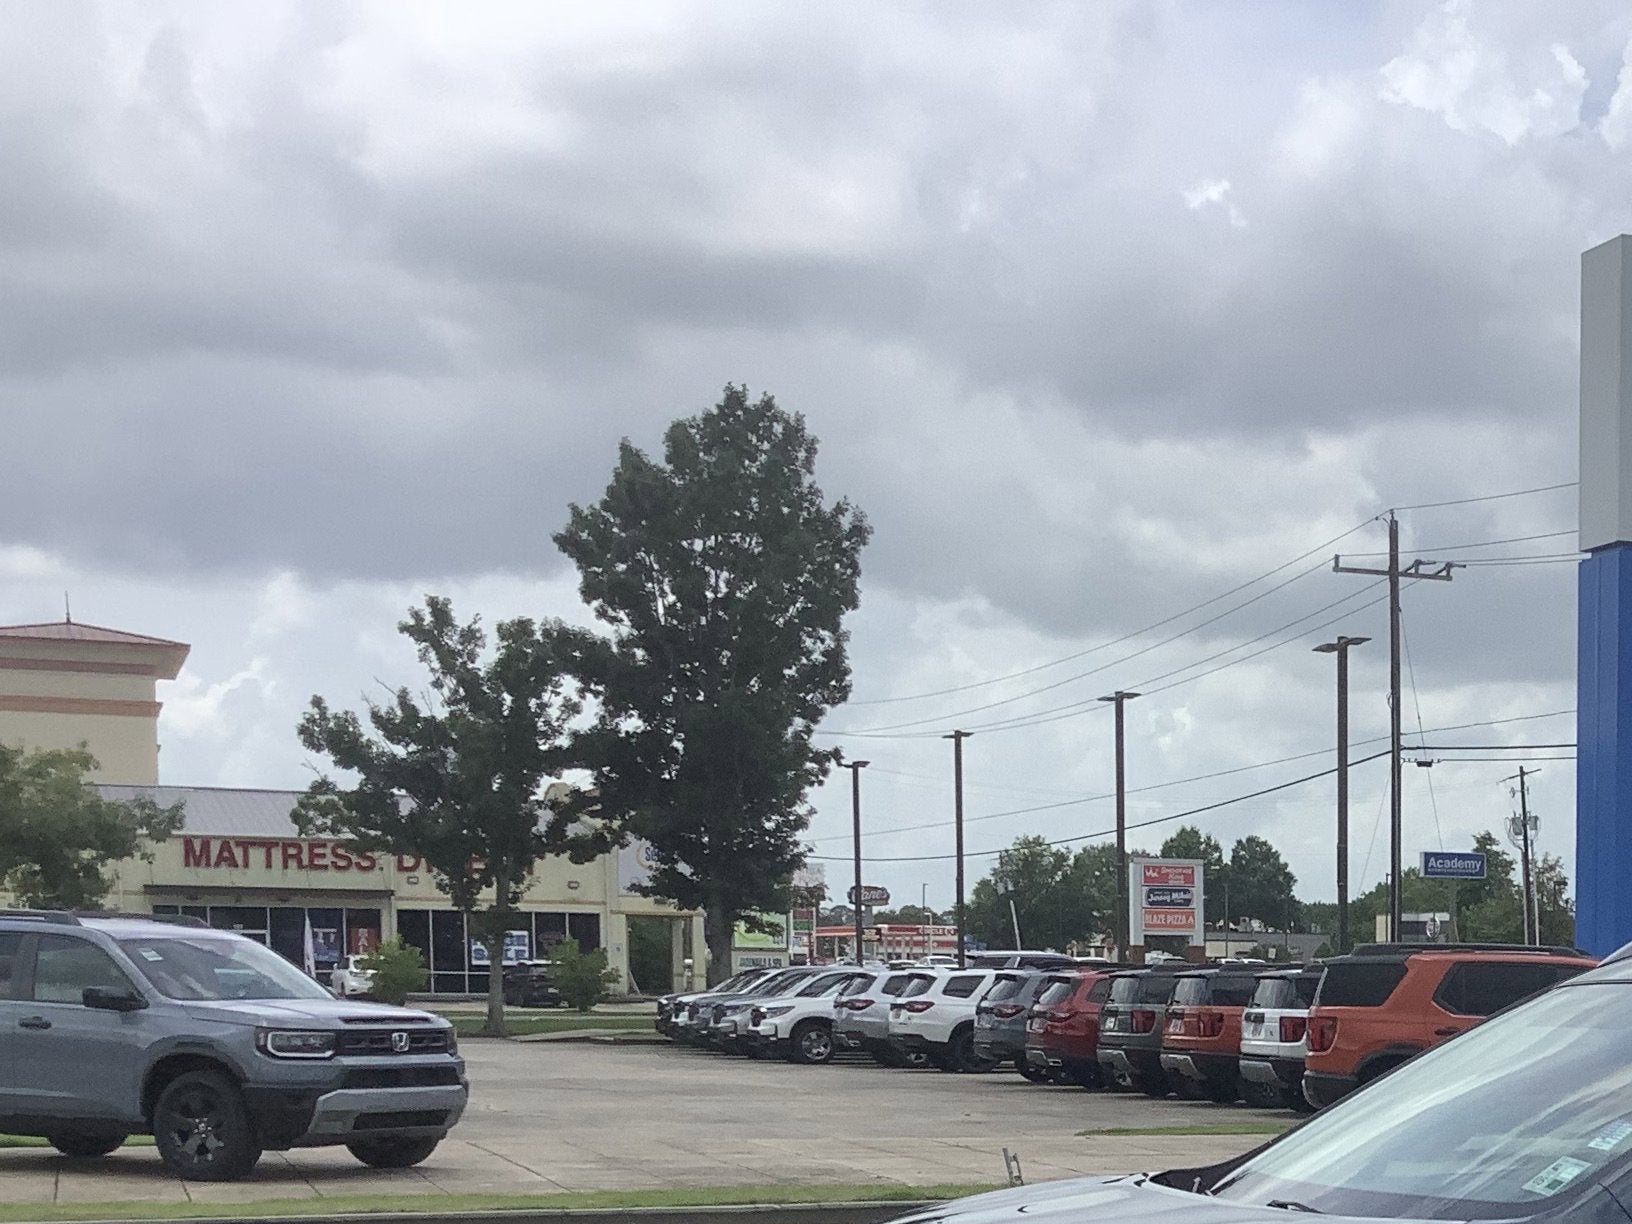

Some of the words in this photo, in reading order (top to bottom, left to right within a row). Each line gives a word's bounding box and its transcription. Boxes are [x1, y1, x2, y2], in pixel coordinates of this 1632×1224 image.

[184, 837, 377, 871] MATTRESS
[1427, 857, 1482, 872] Academy
[1166, 914, 1187, 924] PIZZA
